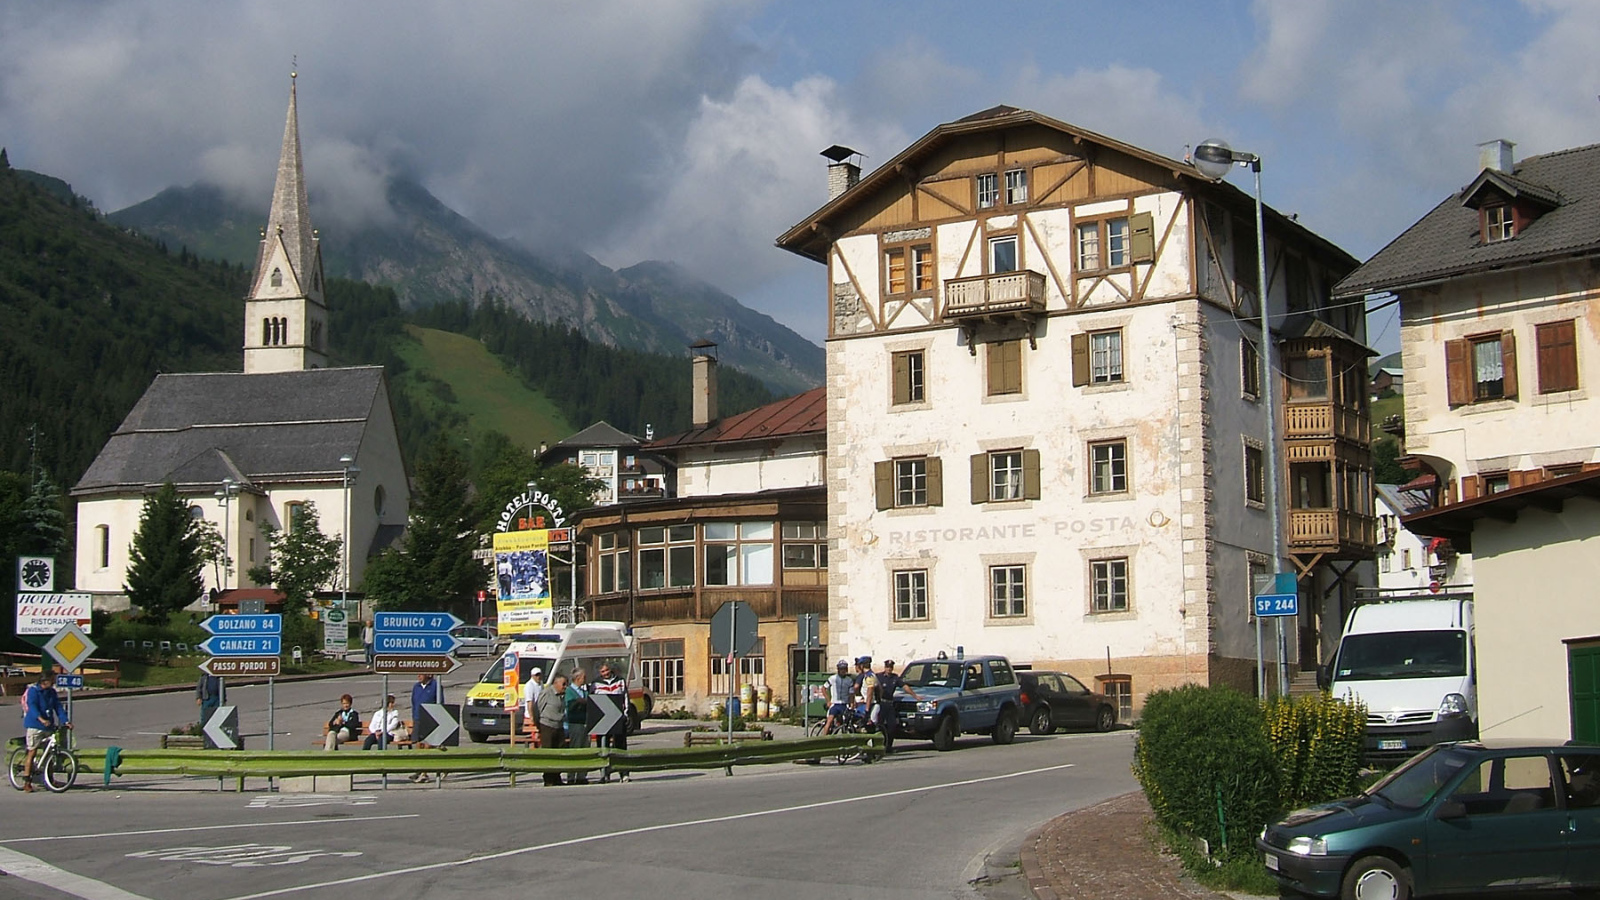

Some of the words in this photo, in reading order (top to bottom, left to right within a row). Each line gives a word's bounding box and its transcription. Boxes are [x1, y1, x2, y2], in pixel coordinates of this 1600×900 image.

[496, 493, 530, 532] HOTEL
[533, 490, 566, 528] POSTA
[518, 516, 545, 530] BAR
[889, 523, 1036, 544] RISTORANTE
[1054, 516, 1136, 535] POSTA
[18, 594, 66, 604] HOTEL
[1257, 600, 1271, 611] SP
[1275, 599, 1294, 610] 244
[18, 605, 84, 616] Evaldo
[218, 620, 256, 629] BOLZANO
[262, 620, 274, 629] 84
[383, 617, 425, 627] BRUNICO
[430, 618, 442, 627] 47
[220, 641, 256, 650] CANAZEI
[262, 641, 272, 650] 21
[383, 638, 426, 648] CORVARA
[432, 638, 442, 648] 10
[213, 662, 236, 670] PASSO
[240, 661, 267, 670] PORDOI
[271, 661, 277, 670] 9
[376, 660, 396, 668] PASSO
[398, 660, 439, 668] CAMPOLONGO
[442, 660, 447, 668] 5
[58, 677, 68, 685] SR
[72, 677, 81, 685] 48
